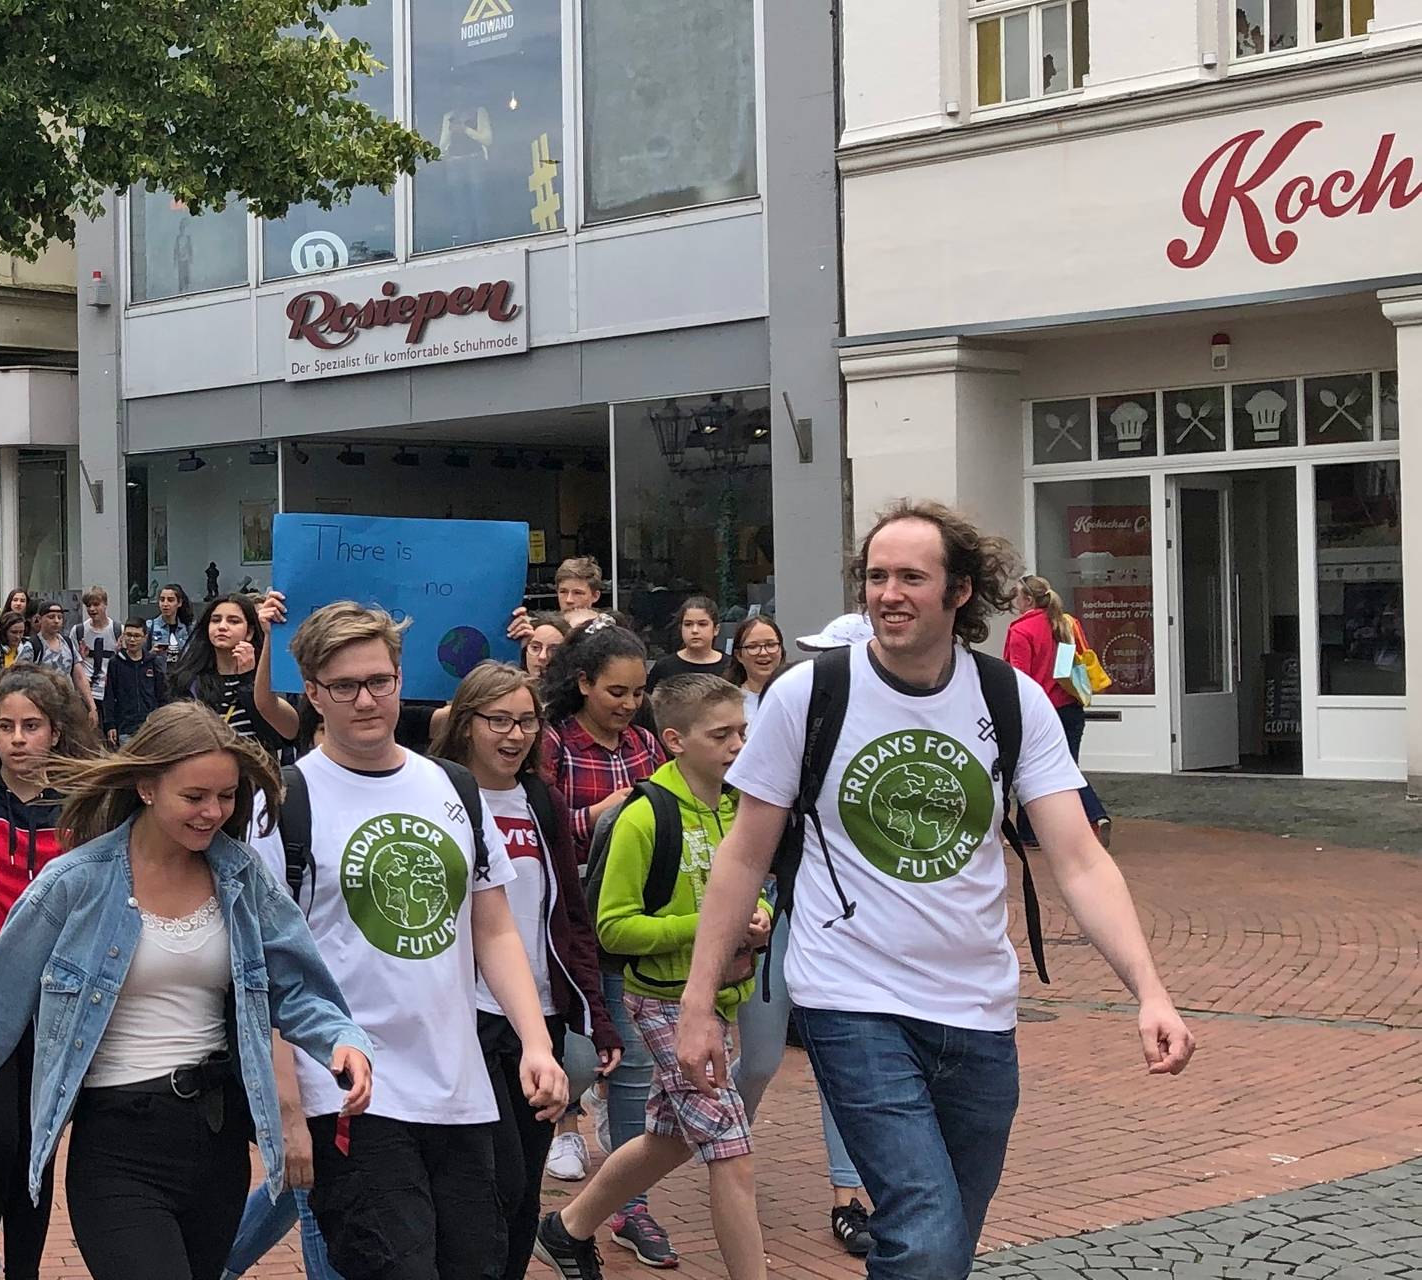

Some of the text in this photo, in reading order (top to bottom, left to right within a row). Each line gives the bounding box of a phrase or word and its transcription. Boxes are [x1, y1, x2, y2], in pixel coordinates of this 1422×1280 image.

[460, 14, 515, 41] NORDWAND
[1166, 120, 1422, 269] Koch
[285, 280, 518, 350] Rosiepen
[291, 333, 519, 375] Der Spezialist für komfortable Schuhmode
[301, 523, 412, 562] There is
[1073, 514, 1133, 533] Kochschule
[425, 581, 454, 597] no
[1082, 610, 1104, 619] oder
[1105, 610, 1132, 619] 02351
[843, 735, 916, 804] FRIDAYS
[924, 736, 969, 771] FOR
[345, 818, 444, 889] FRIDAYS FOR
[503, 828, 539, 847] VI'S
[896, 831, 979, 878] FUTURE
[396, 916, 456, 955] FUTUR
